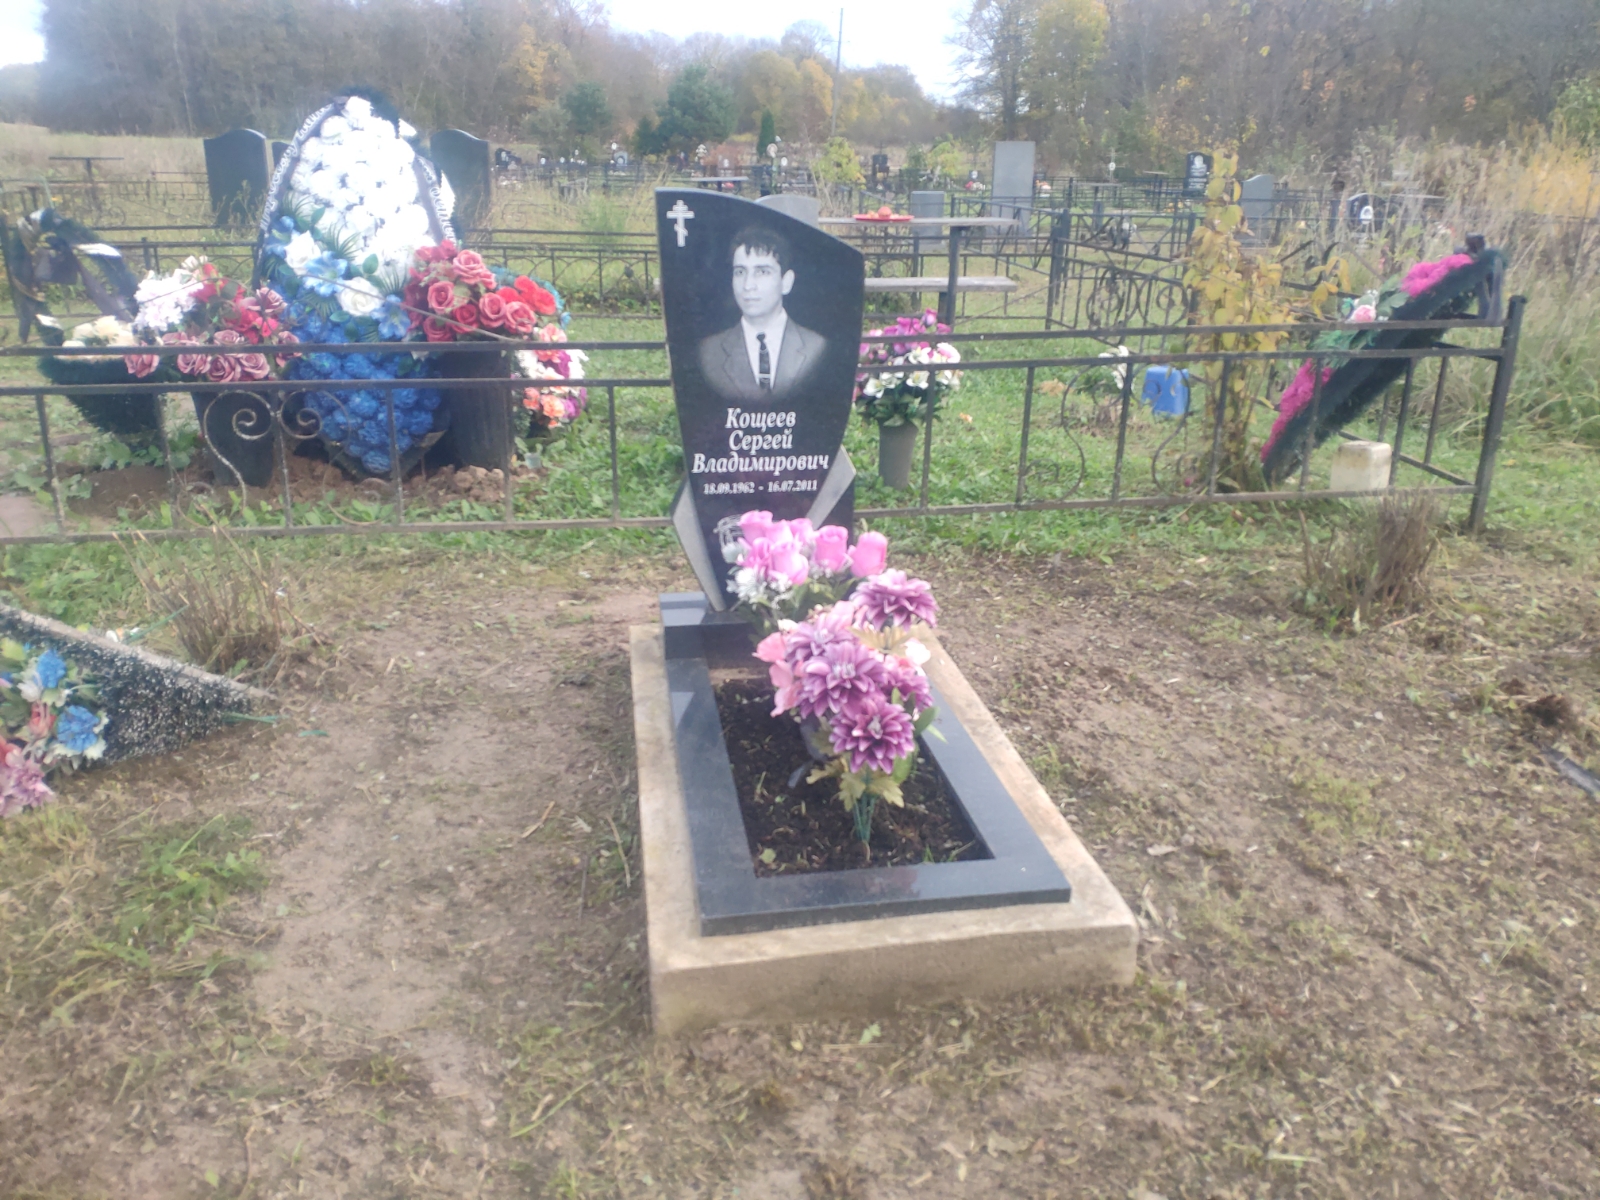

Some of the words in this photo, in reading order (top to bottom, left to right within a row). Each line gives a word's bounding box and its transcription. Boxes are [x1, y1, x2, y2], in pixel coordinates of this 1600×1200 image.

[725, 407, 797, 433] Кощеев
[728, 428, 793, 455] Сергей
[691, 451, 829, 476] Владимирович
